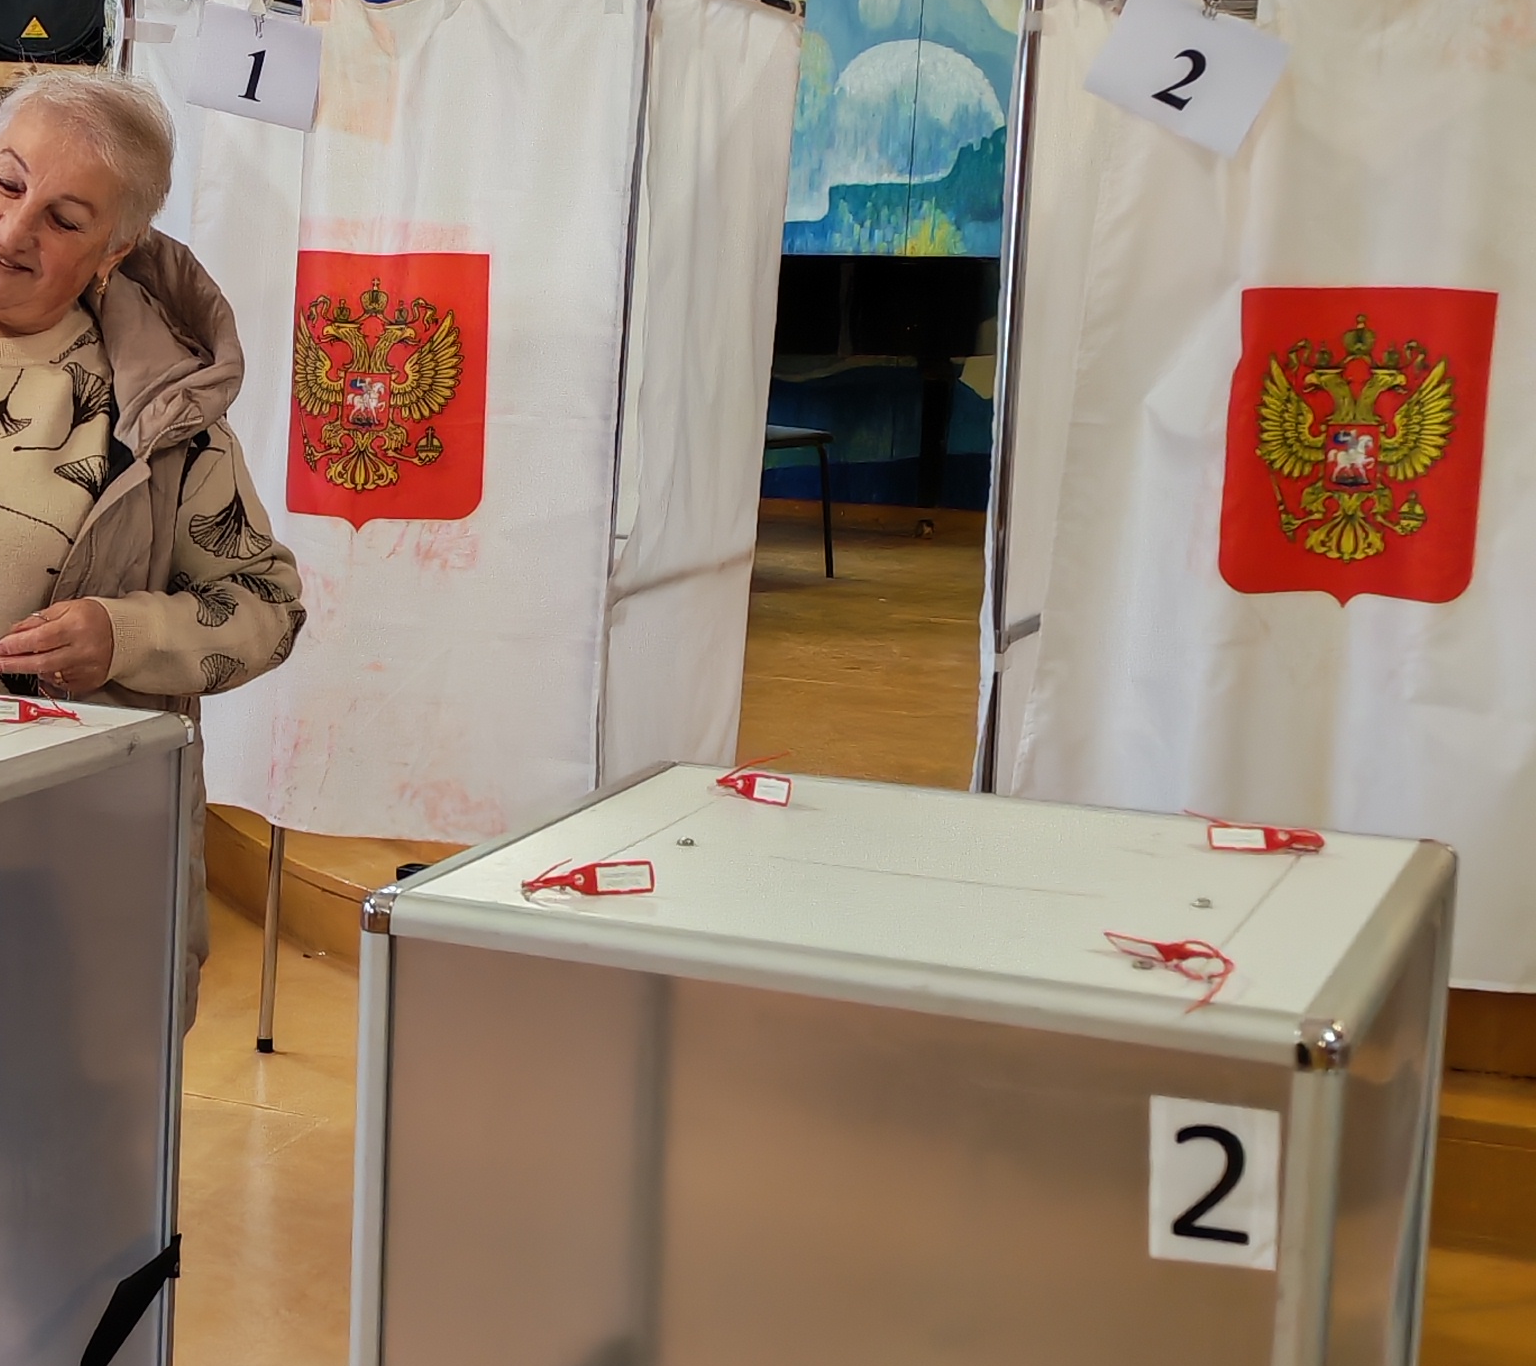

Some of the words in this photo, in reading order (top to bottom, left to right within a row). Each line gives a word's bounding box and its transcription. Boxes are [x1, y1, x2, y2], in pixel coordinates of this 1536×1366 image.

[237, 49, 266, 102] 1
[1151, 48, 1207, 111] 2
[1172, 1123, 1249, 1245] 2
